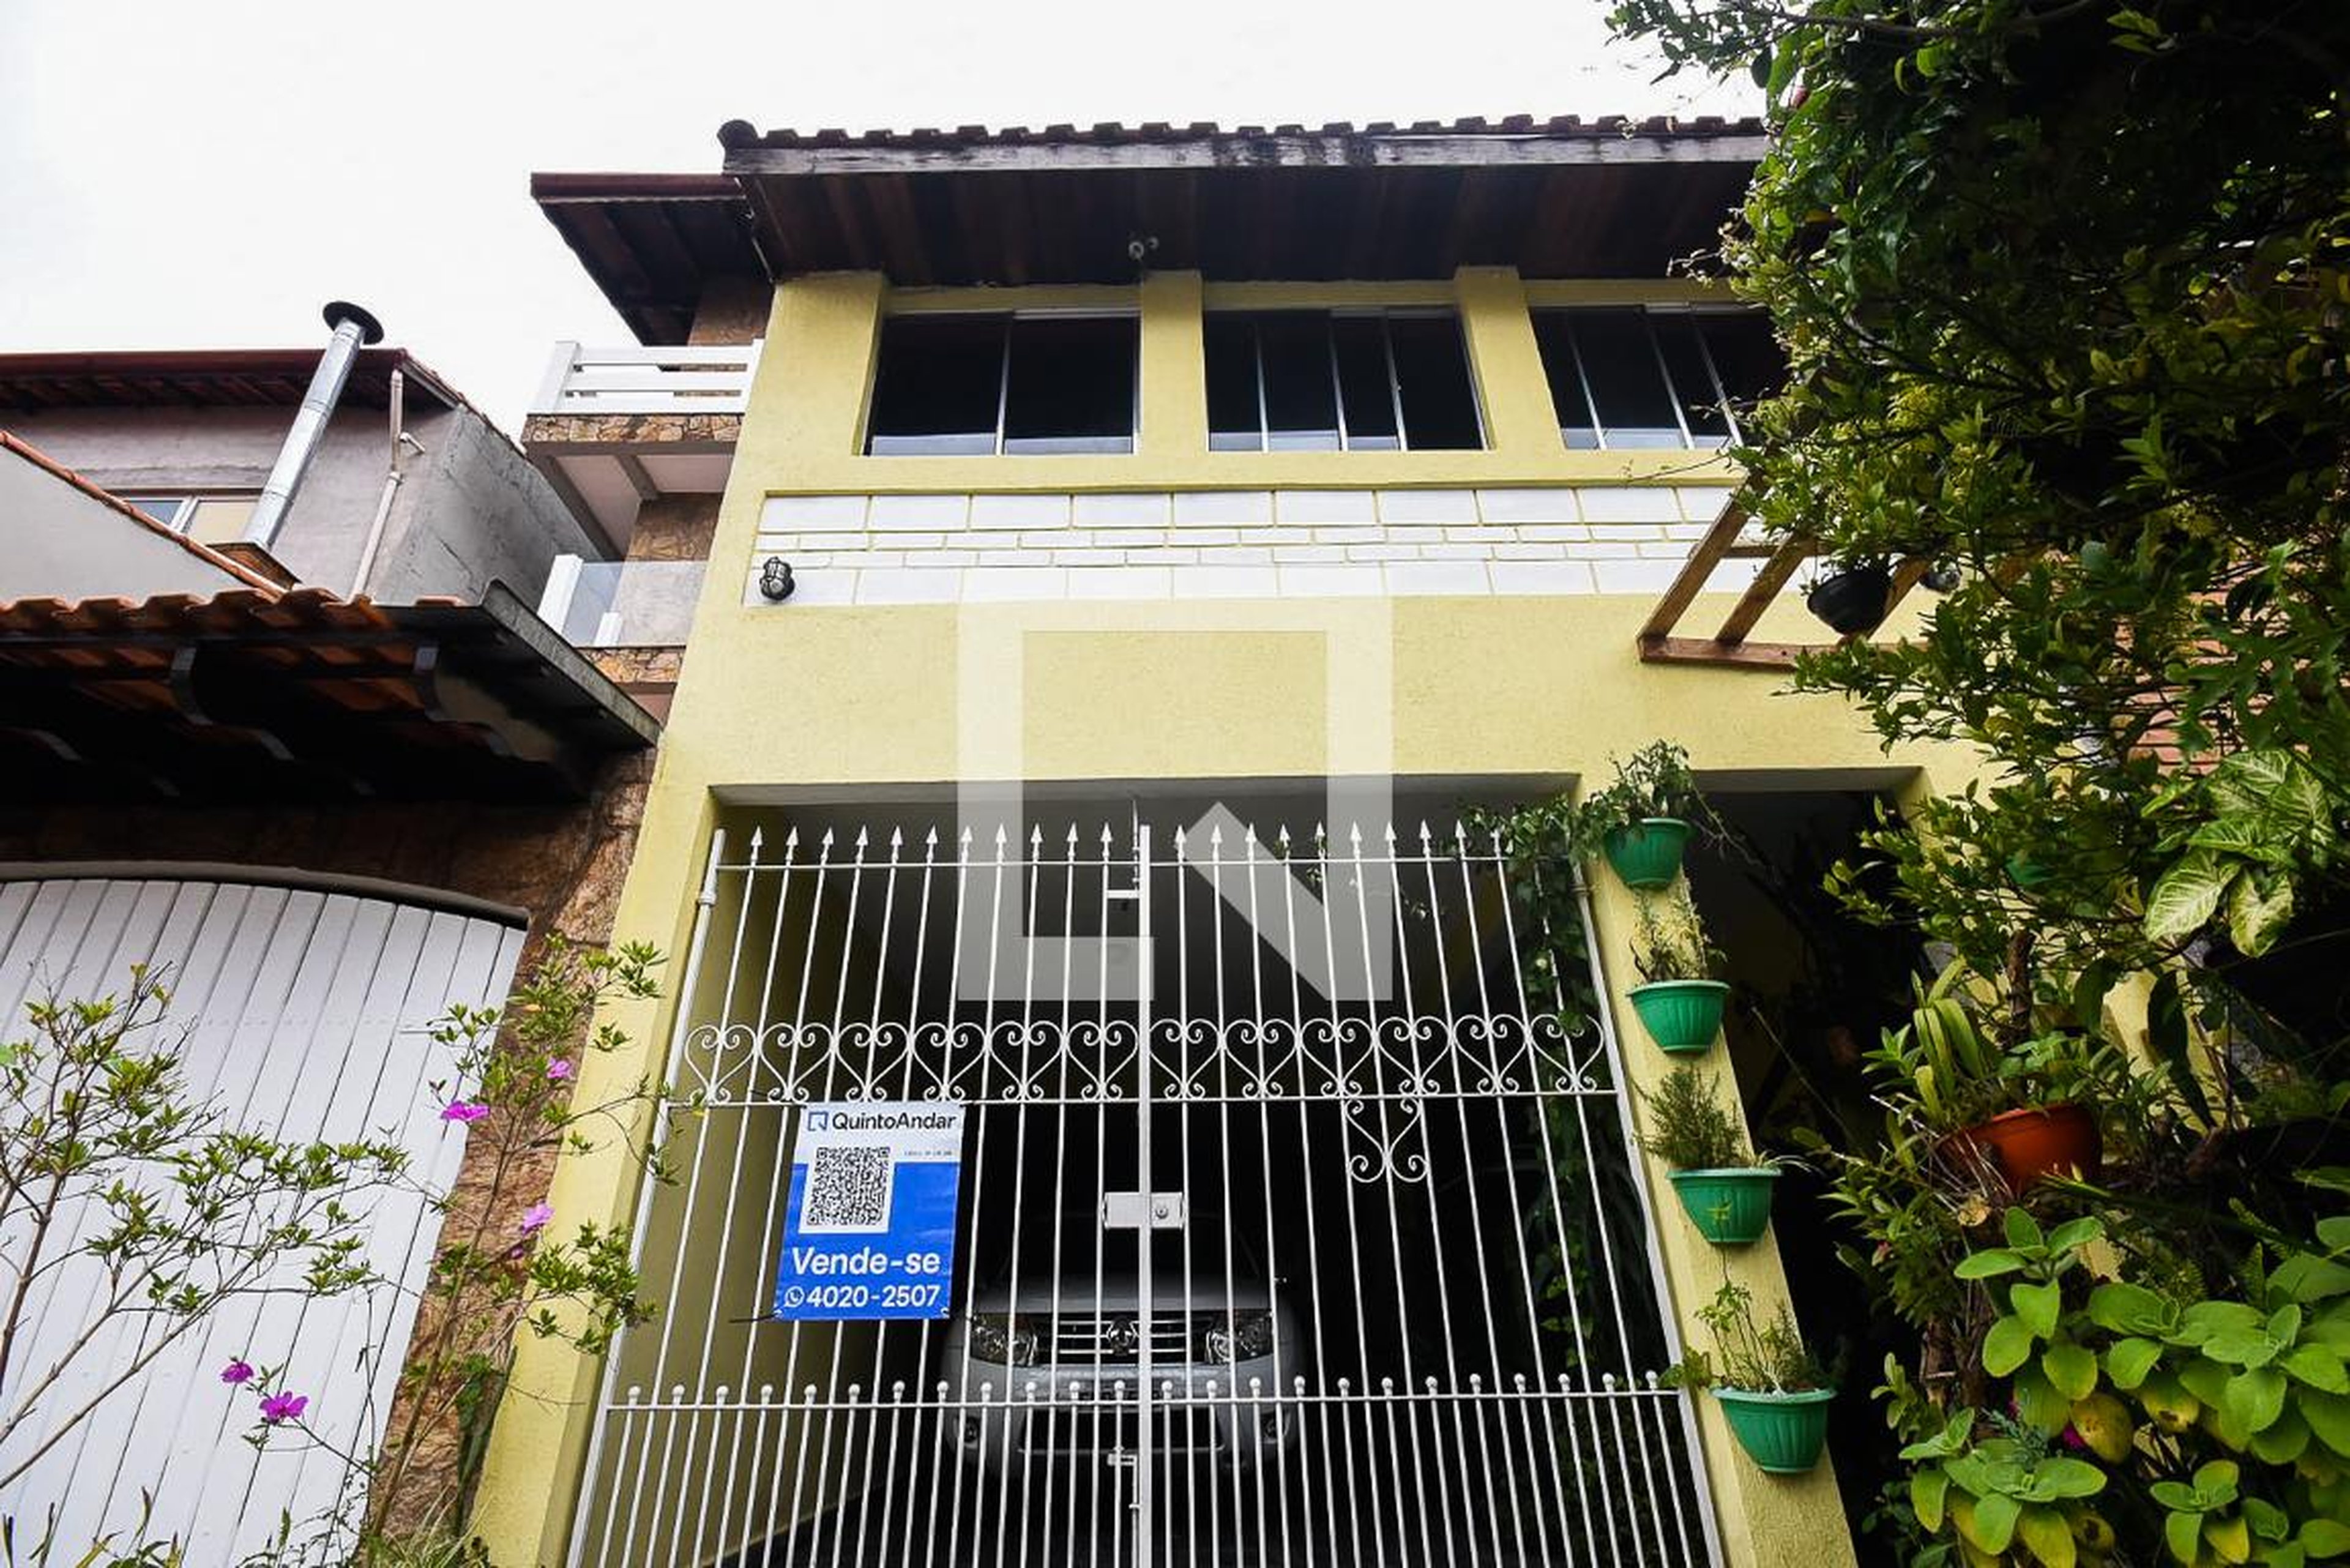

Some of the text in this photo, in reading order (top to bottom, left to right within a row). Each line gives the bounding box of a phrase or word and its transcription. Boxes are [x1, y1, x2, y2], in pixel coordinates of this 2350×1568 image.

[832, 1112, 956, 1130] QuintoAndar
[793, 1247, 941, 1275] Vende-se
[807, 1285, 941, 1307] 4020-2507
